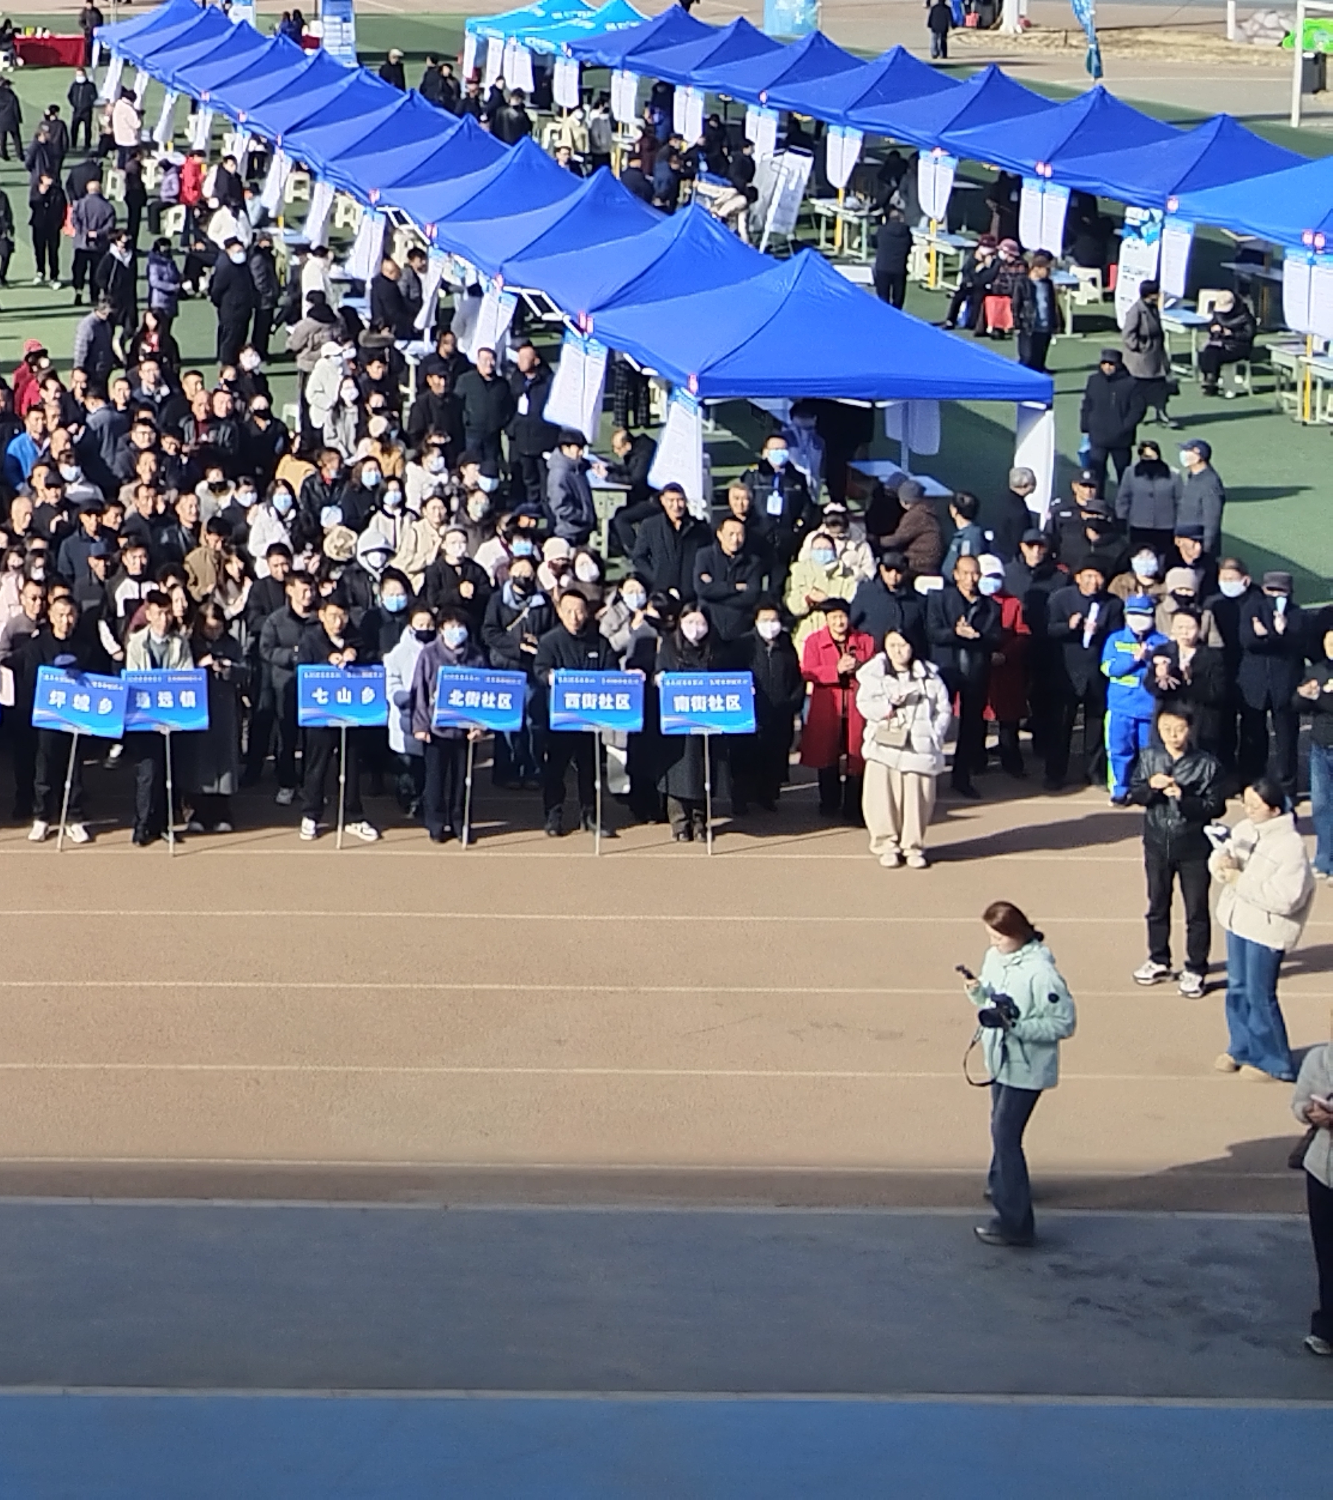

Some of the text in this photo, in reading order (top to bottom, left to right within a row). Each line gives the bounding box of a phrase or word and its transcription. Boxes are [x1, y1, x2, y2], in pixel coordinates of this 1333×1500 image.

[311, 686, 376, 704] 七山乡
[447, 689, 513, 710] 北街社区
[564, 692, 630, 710] 西街社区
[673, 694, 742, 712] 南街社区
